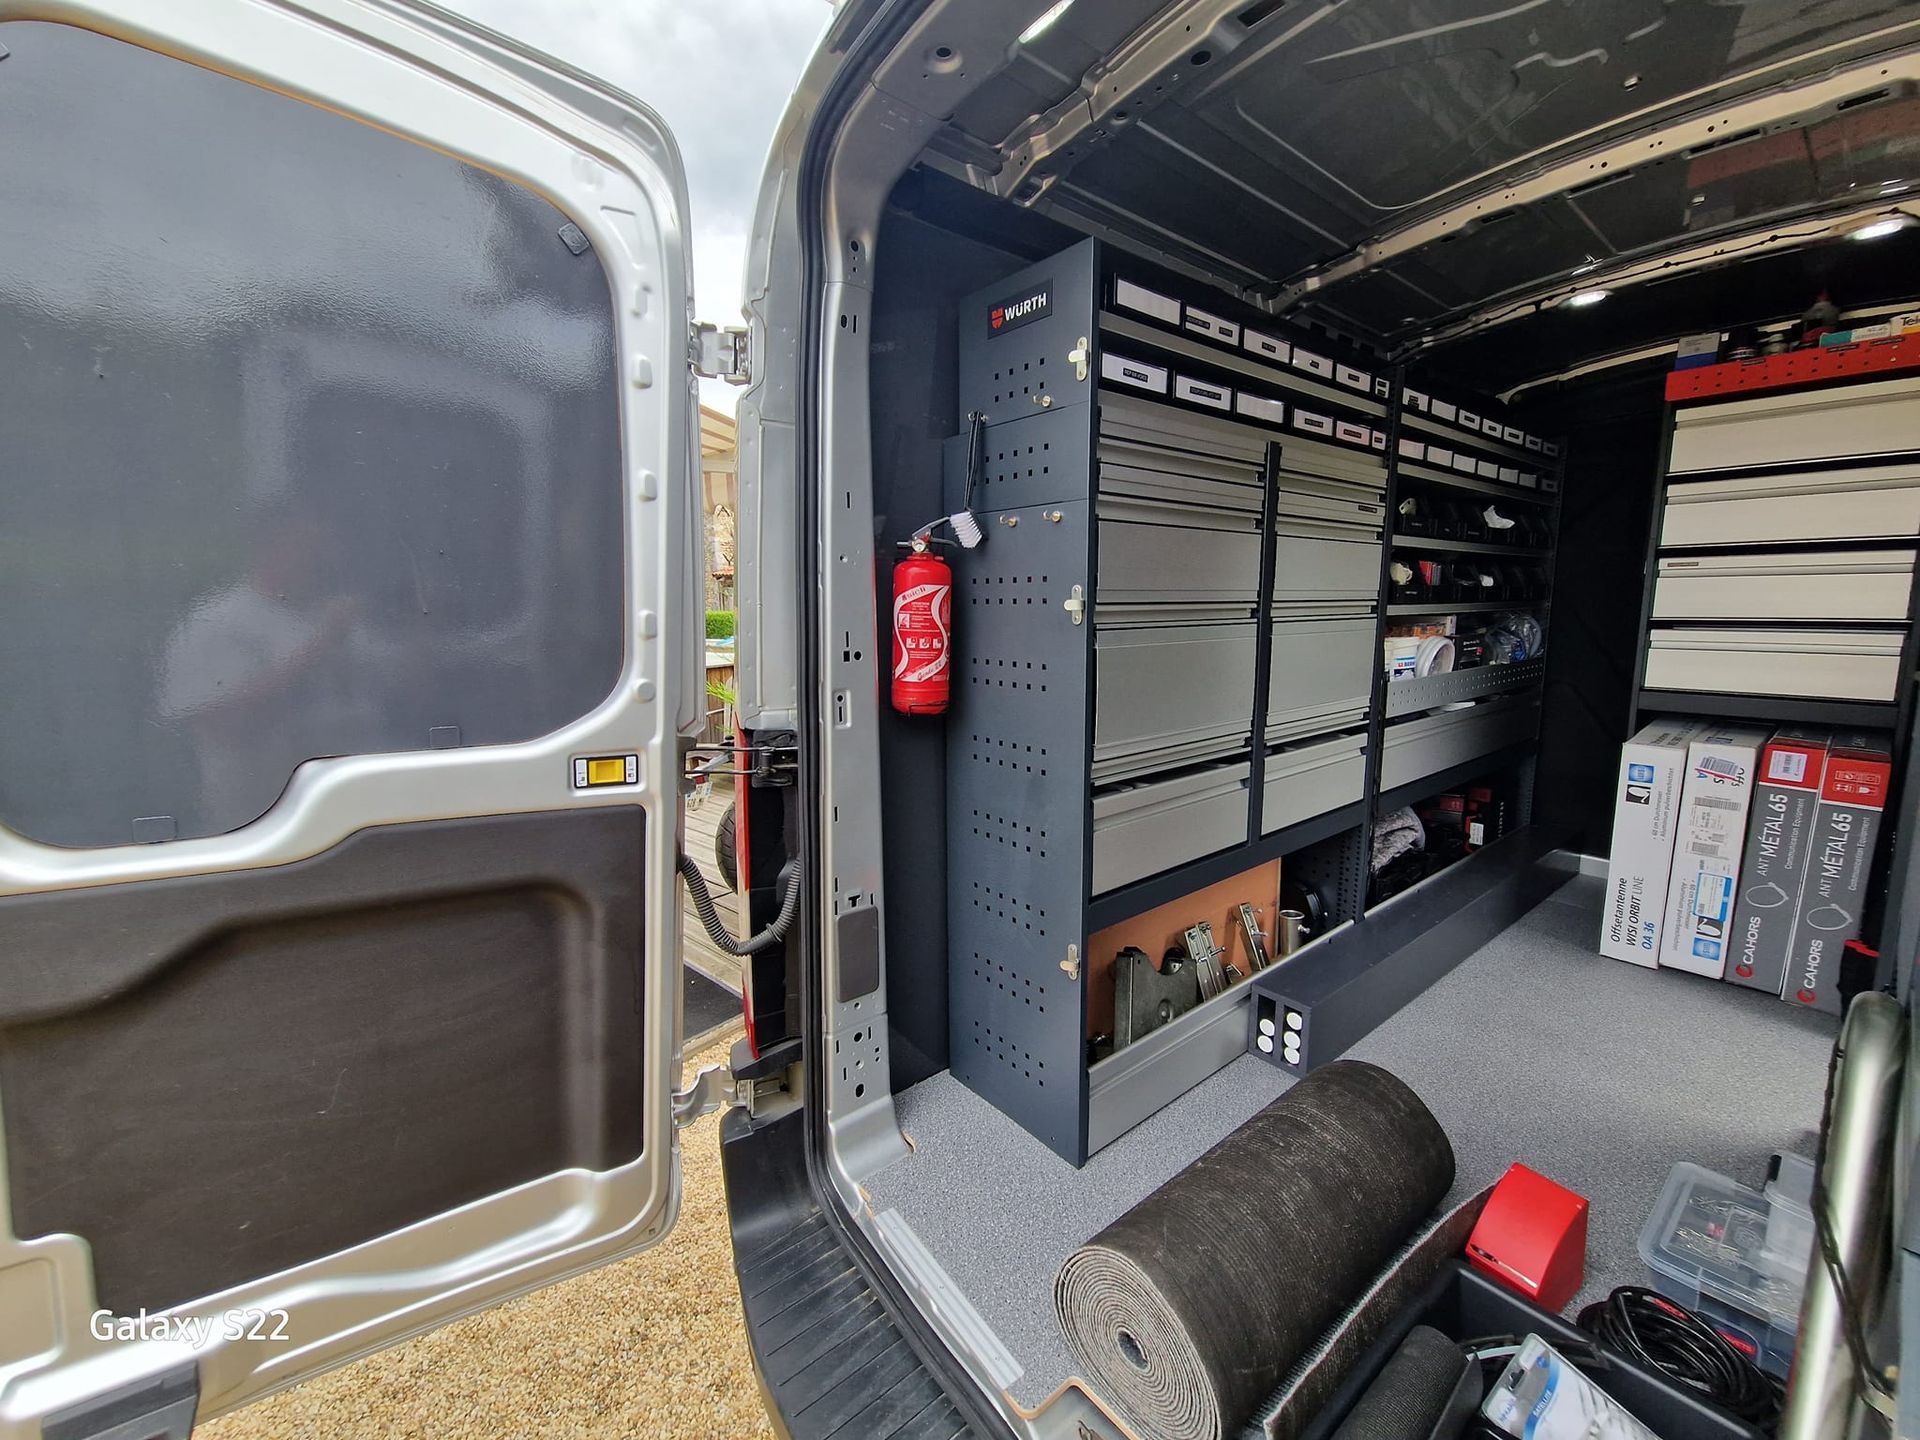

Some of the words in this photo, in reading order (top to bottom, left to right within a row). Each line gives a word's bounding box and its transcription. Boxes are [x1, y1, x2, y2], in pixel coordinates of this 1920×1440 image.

[1004, 292, 1047, 321] WÜRTH
[1791, 798, 1806, 828] Equipment
[1756, 857, 1770, 877] ANT
[1632, 875, 1644, 895] LINE
[1818, 878, 1833, 898] ANT
[1610, 877, 1628, 943] Offsetantenne
[1628, 895, 1641, 924] ORBIT
[1625, 925, 1639, 947] WISI
[1643, 921, 1655, 934] 36
[1641, 935, 1653, 950] OA
[1743, 916, 1761, 965] CAHORS
[1803, 939, 1824, 989] CAHORS
